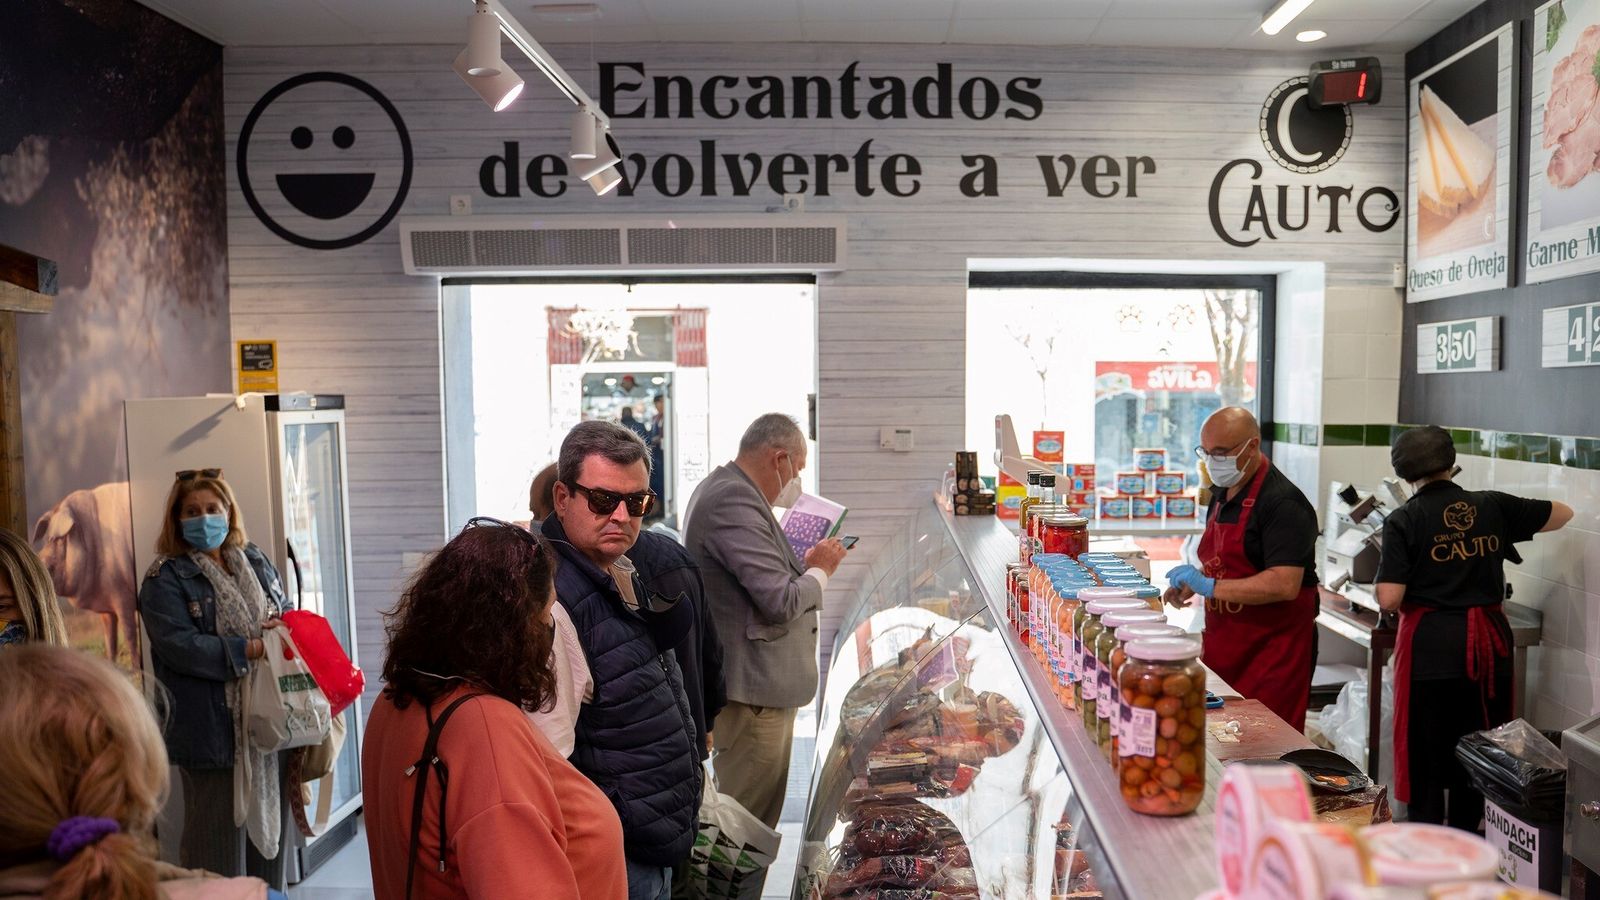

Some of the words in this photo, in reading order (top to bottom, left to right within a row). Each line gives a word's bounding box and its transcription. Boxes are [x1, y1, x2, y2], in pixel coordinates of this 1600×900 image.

[597, 61, 1044, 121] Encantados
[1358, 72, 1367, 98] 1
[479, 141, 569, 198] de
[615, 138, 922, 198] volverte
[959, 154, 999, 198] a
[1036, 154, 1157, 198] ver
[1208, 158, 1400, 248] CAUTO
[1409, 269, 1443, 293] Queso
[1448, 260, 1463, 282] de
[1468, 251, 1506, 279] Oveja
[1529, 238, 1578, 268] Carne
[1431, 535, 1500, 562] CAUTO
[1434, 531, 1466, 543] GRUPO
[1486, 805, 1537, 852] SANDACH
